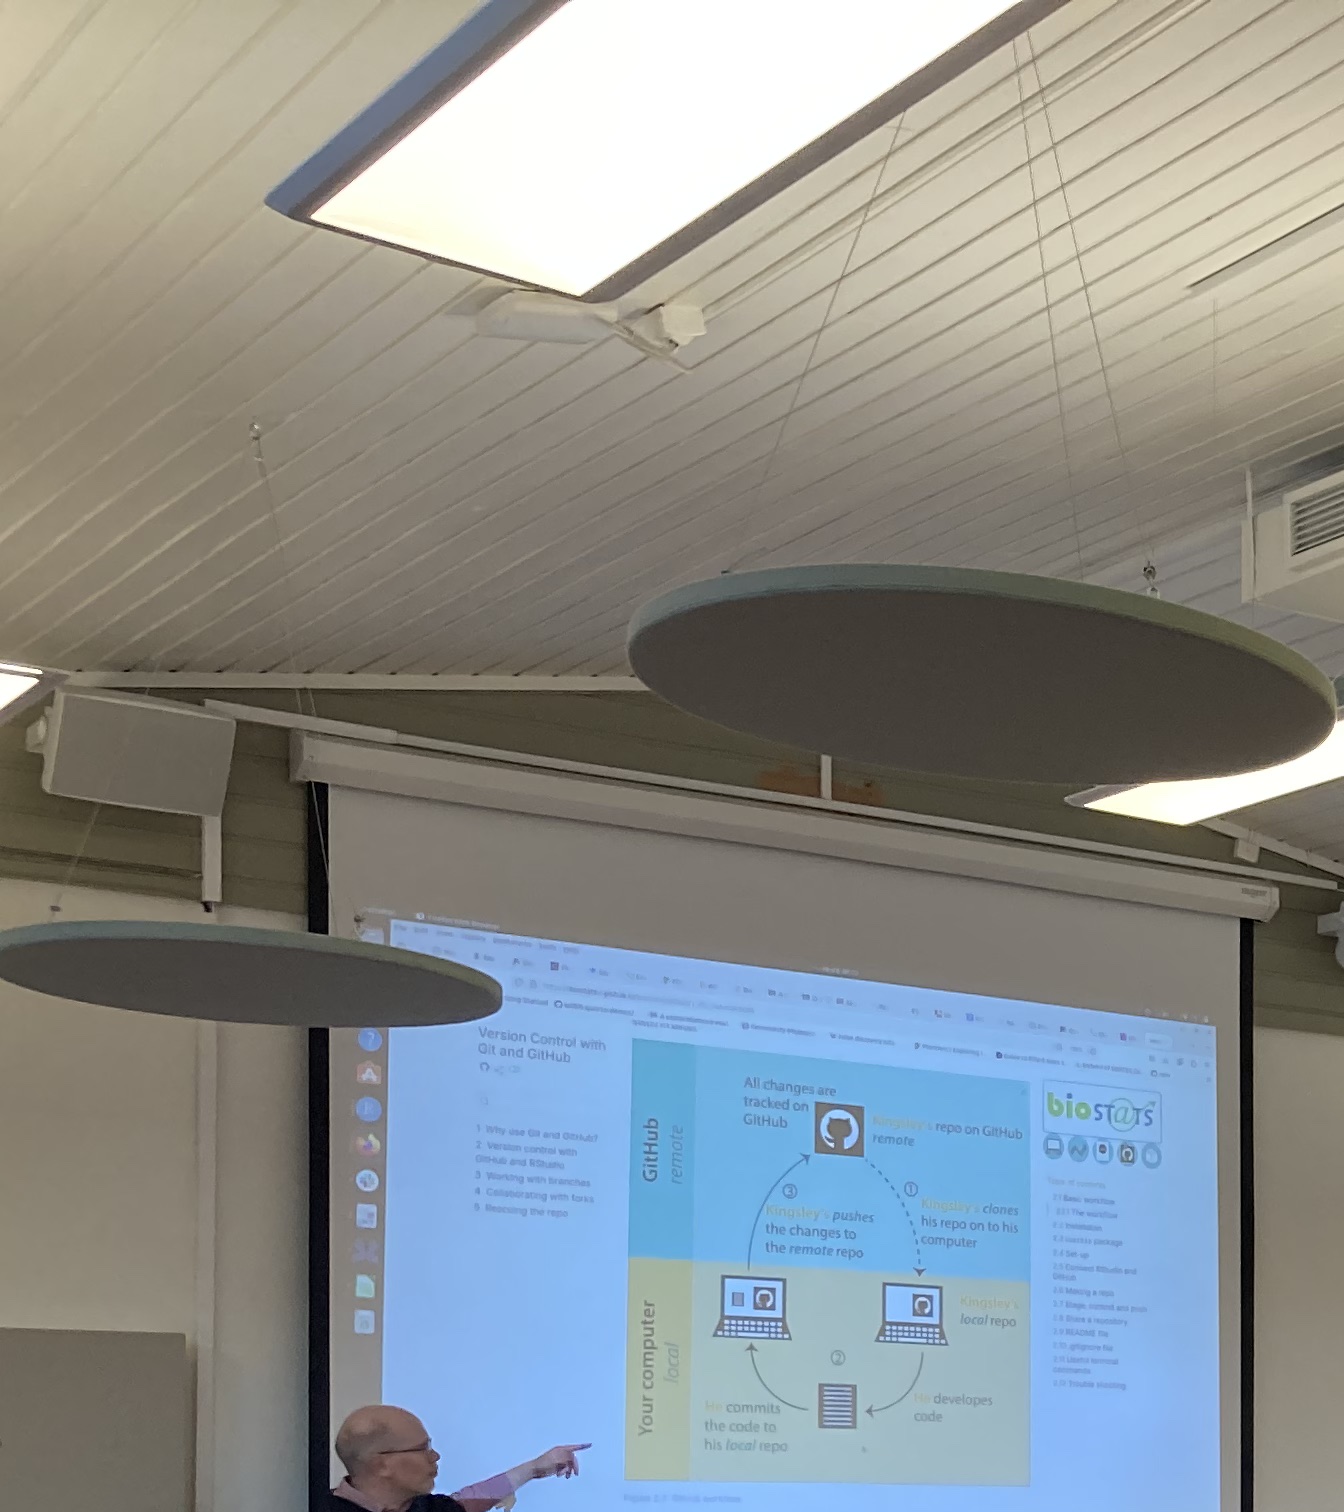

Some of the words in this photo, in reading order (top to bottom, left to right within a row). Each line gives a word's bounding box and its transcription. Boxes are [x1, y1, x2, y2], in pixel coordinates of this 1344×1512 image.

[478, 1025, 526, 1043] Version
[530, 1032, 576, 1048] Control
[580, 1039, 606, 1051] with
[478, 1042, 496, 1055] Git
[500, 1047, 524, 1058] and
[527, 1048, 571, 1063] GitHub
[744, 1076, 760, 1089] All
[763, 1079, 814, 1096] changes
[816, 1086, 837, 1097] are
[744, 1096, 790, 1111] tracked
[793, 1103, 809, 1112] on
[743, 1113, 788, 1128] GitHub
[486, 1125, 506, 1137] Why
[509, 1128, 525, 1137] use
[543, 1131, 560, 1139] and
[935, 1122, 962, 1135] repo
[965, 1127, 979, 1135] on
[982, 1126, 1023, 1140] GitHub
[872, 1133, 915, 1146] remote
[487, 1141, 521, 1151] Version
[524, 1145, 556, 1155] control
[559, 1147, 577, 1156] with
[642, 1117, 659, 1182] GitHub
[669, 1124, 685, 1184] remote
[475, 1155, 507, 1164] GitHub
[510, 1158, 526, 1166] and
[529, 1159, 565, 1169] RStudio
[486, 1172, 524, 1184] Working
[527, 1175, 546, 1184] with
[549, 1176, 590, 1187] branches
[550, 1194, 569, 1202] with
[530, 1208, 544, 1216] the
[547, 1209, 568, 1218] repo
[833, 1211, 874, 1222] pushes
[982, 1203, 1019, 1216] clones
[766, 1222, 787, 1235] the
[789, 1225, 841, 1240] changes
[844, 1228, 857, 1239] to
[921, 1215, 938, 1227] his
[940, 1218, 966, 1231] repo
[969, 1222, 985, 1231] on
[987, 1221, 999, 1232] to
[1002, 1221, 1019, 1233] his
[921, 1234, 977, 1248] computer
[766, 1241, 787, 1254] the
[789, 1244, 834, 1257] remote
[836, 1247, 864, 1261] repo
[960, 1313, 988, 1326] local
[990, 1316, 1017, 1329] repo
[640, 1300, 657, 1390] computer
[663, 1341, 680, 1385] local
[933, 1393, 993, 1407] developes
[638, 1394, 655, 1436] Your
[726, 1401, 781, 1415] commits
[914, 1411, 943, 1422] code
[704, 1419, 725, 1432] the
[729, 1421, 760, 1433] code
[764, 1421, 777, 1433] to
[704, 1438, 722, 1451] his
[725, 1439, 756, 1451] local
[759, 1441, 788, 1456] repo
